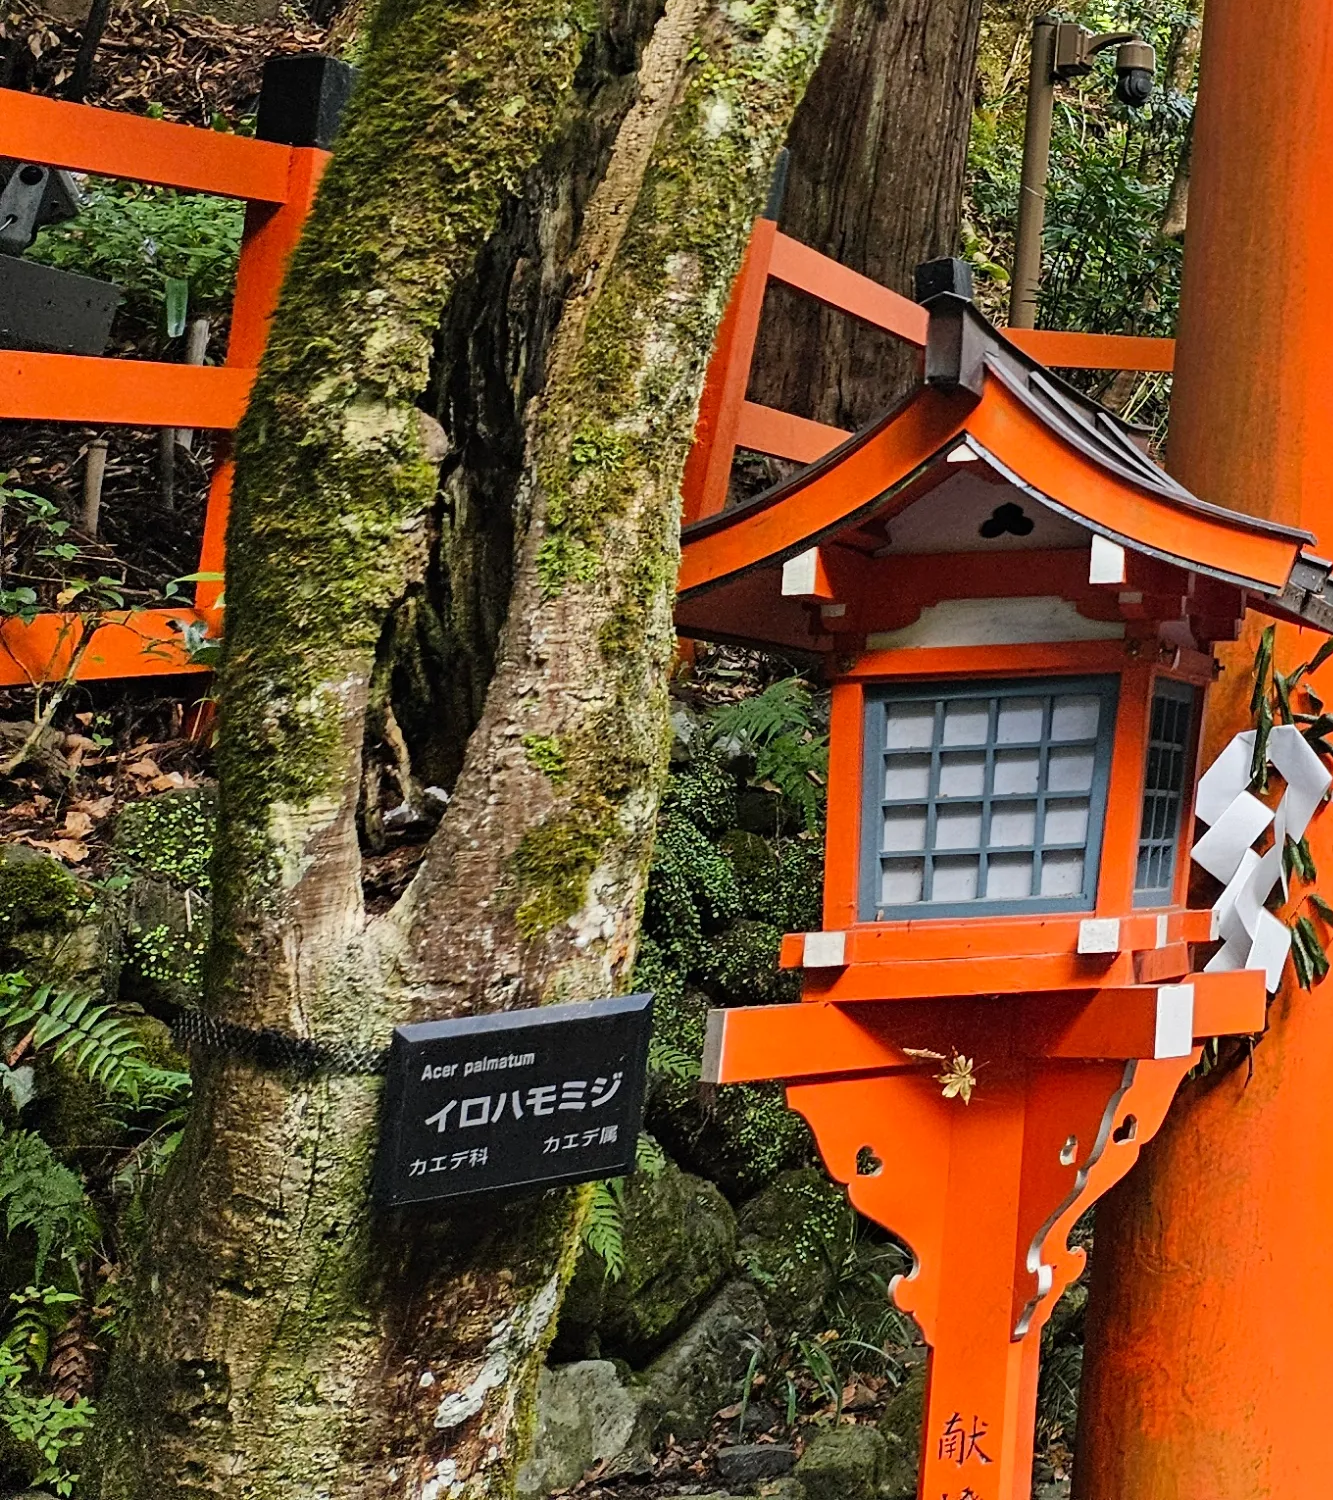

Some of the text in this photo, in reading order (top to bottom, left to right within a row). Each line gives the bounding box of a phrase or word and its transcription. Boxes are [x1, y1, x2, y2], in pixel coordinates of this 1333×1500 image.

[421, 1052, 536, 1081] Acer palmatum
[425, 1071, 624, 1134] イロハモミジ
[409, 1124, 619, 1177] カエデ科 カエデ属
